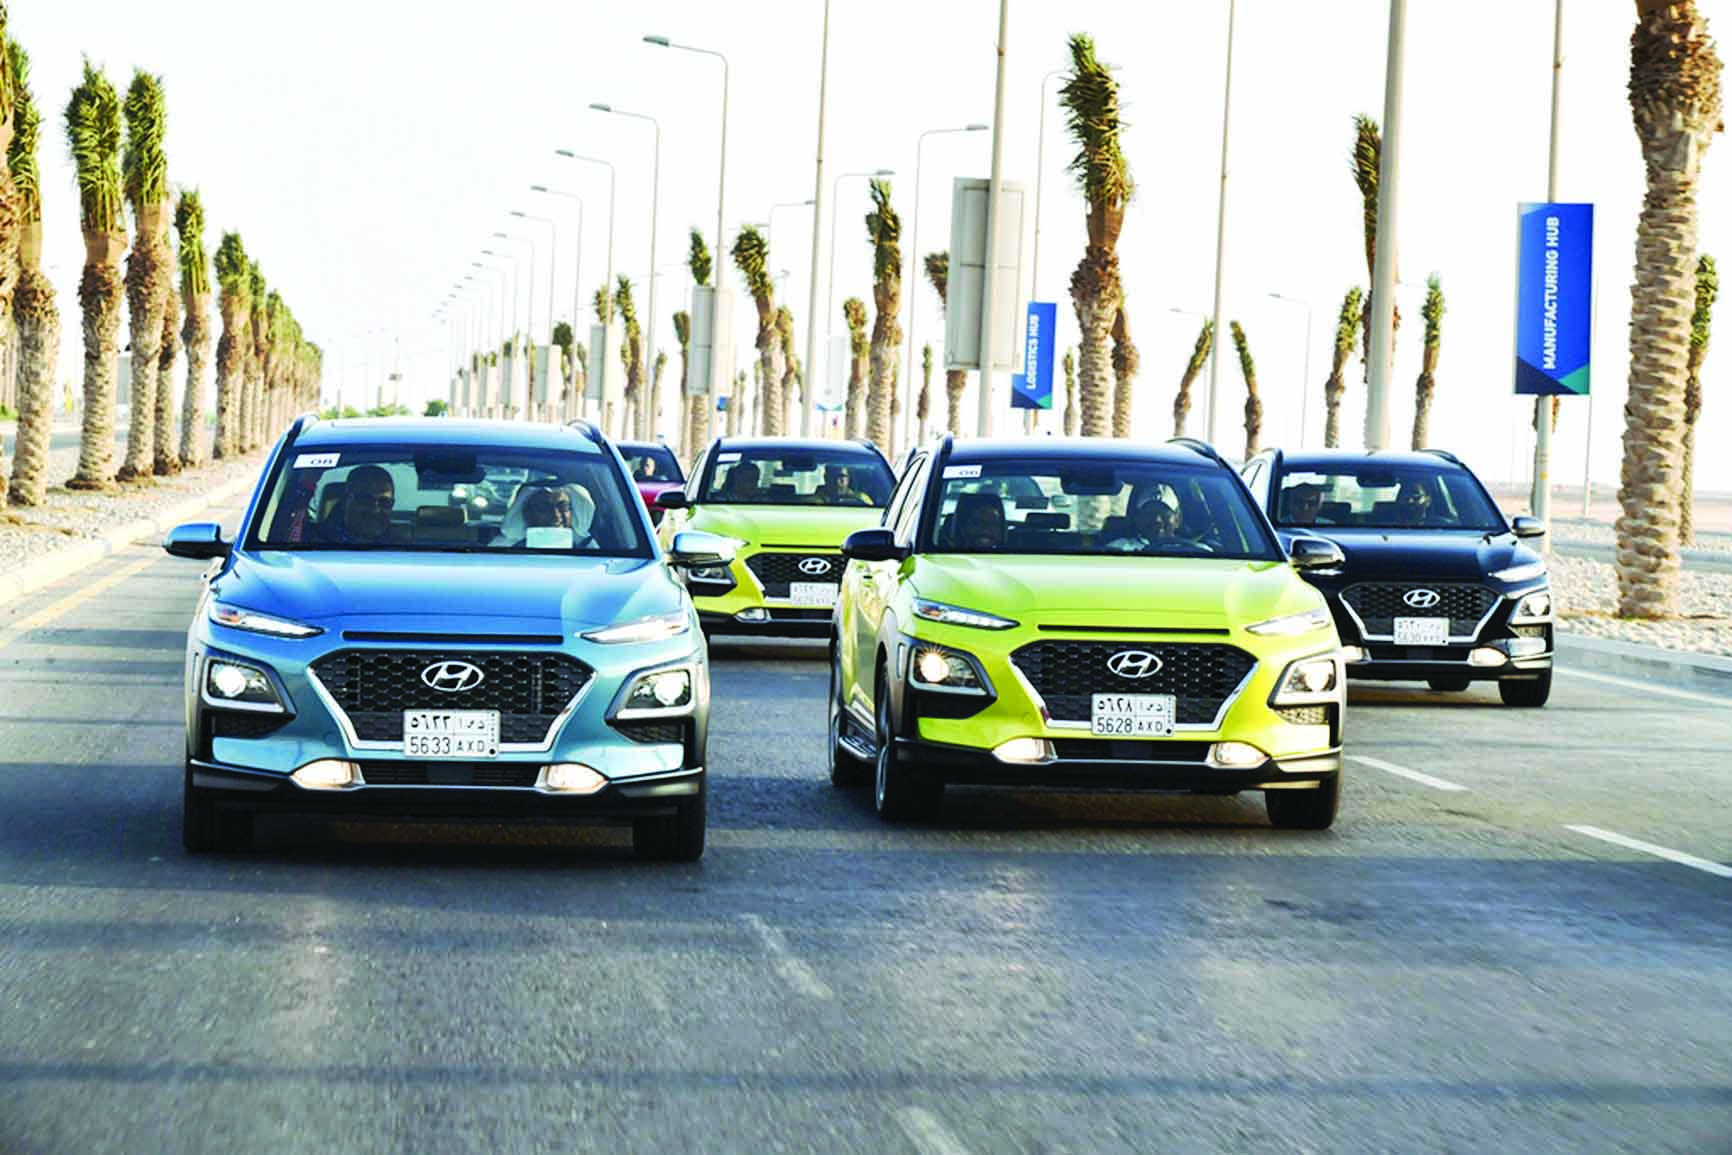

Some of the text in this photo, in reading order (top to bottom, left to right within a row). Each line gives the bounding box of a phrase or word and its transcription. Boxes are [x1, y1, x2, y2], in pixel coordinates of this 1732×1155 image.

[1543, 216, 1560, 370] MANUFACTURING HUB
[1025, 313, 1040, 390] LOGISTICS HUB
[410, 735, 451, 755] 5633
[1097, 716, 1133, 733] 5628
